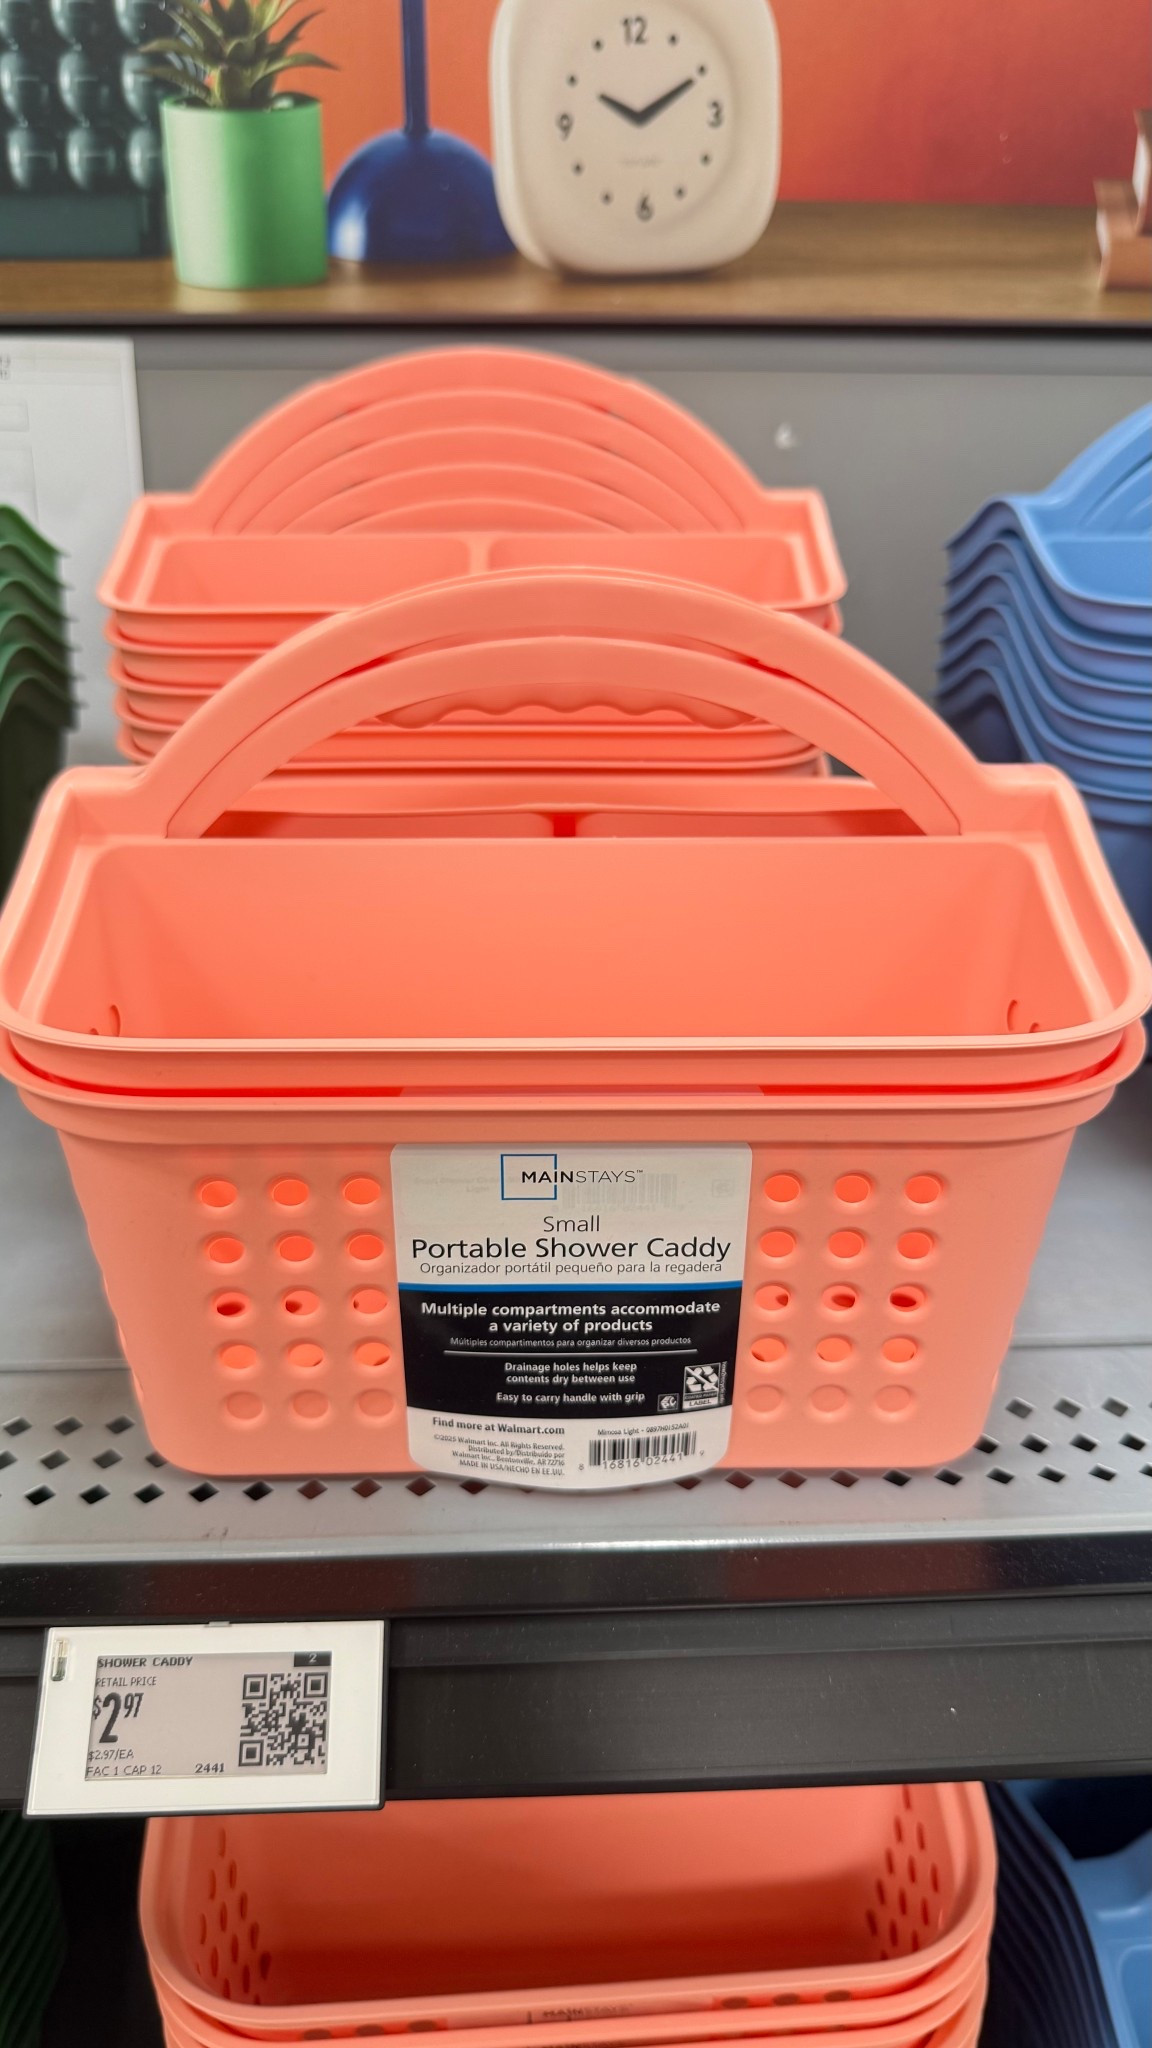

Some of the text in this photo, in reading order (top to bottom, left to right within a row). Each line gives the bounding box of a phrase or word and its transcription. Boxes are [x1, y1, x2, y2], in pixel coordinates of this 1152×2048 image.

[622, 16, 647, 45] 12
[707, 100, 723, 129] 3
[556, 113, 573, 141] 9
[636, 194, 654, 222] 6
[543, 1216, 600, 1233] Small
[412, 1236, 731, 1262] Portable Shower Caddy
[420, 1261, 722, 1276] Organizador portátil pequeño para la regadera
[421, 1296, 721, 1318] Multiple compartments accommodate
[489, 1319, 653, 1334] a variety of products
[450, 1337, 692, 1348] Múltiples compartimentos para organizar diversos productos
[504, 1362, 637, 1373] Drainage holes helps keep
[506, 1374, 635, 1386] contents dry between use
[496, 1392, 646, 1406] Easy to carry handle with grip
[689, 1399, 712, 1407] LABEL
[432, 1417, 565, 1435] Find more at Walmart.com
[623, 1427, 640, 1436] Light
[457, 1436, 486, 1446] Walmart
[510, 1442, 532, 1451] Rights
[532, 1442, 564, 1451] Reserved.
[452, 1450, 480, 1460] Walmart
[468, 1445, 504, 1455] Distributed
[553, 1452, 565, 1460] por
[459, 1459, 479, 1468] MADE
[490, 1462, 530, 1474] USA/HECHO
[531, 1466, 540, 1474] EN
[541, 1467, 564, 1476] EE.UU.
[578, 1463, 585, 1471] 8
[602, 1458, 640, 1470] 16816
[645, 1453, 682, 1466] 02441
[97, 1656, 193, 1668] SHOWER CADDY
[308, 1652, 317, 1663] 2
[95, 1676, 157, 1687] RETAIL PRICE
[88, 1748, 134, 1761] $2.97/EA
[86, 1763, 225, 1776] FAC 1 CAP 12 2441
